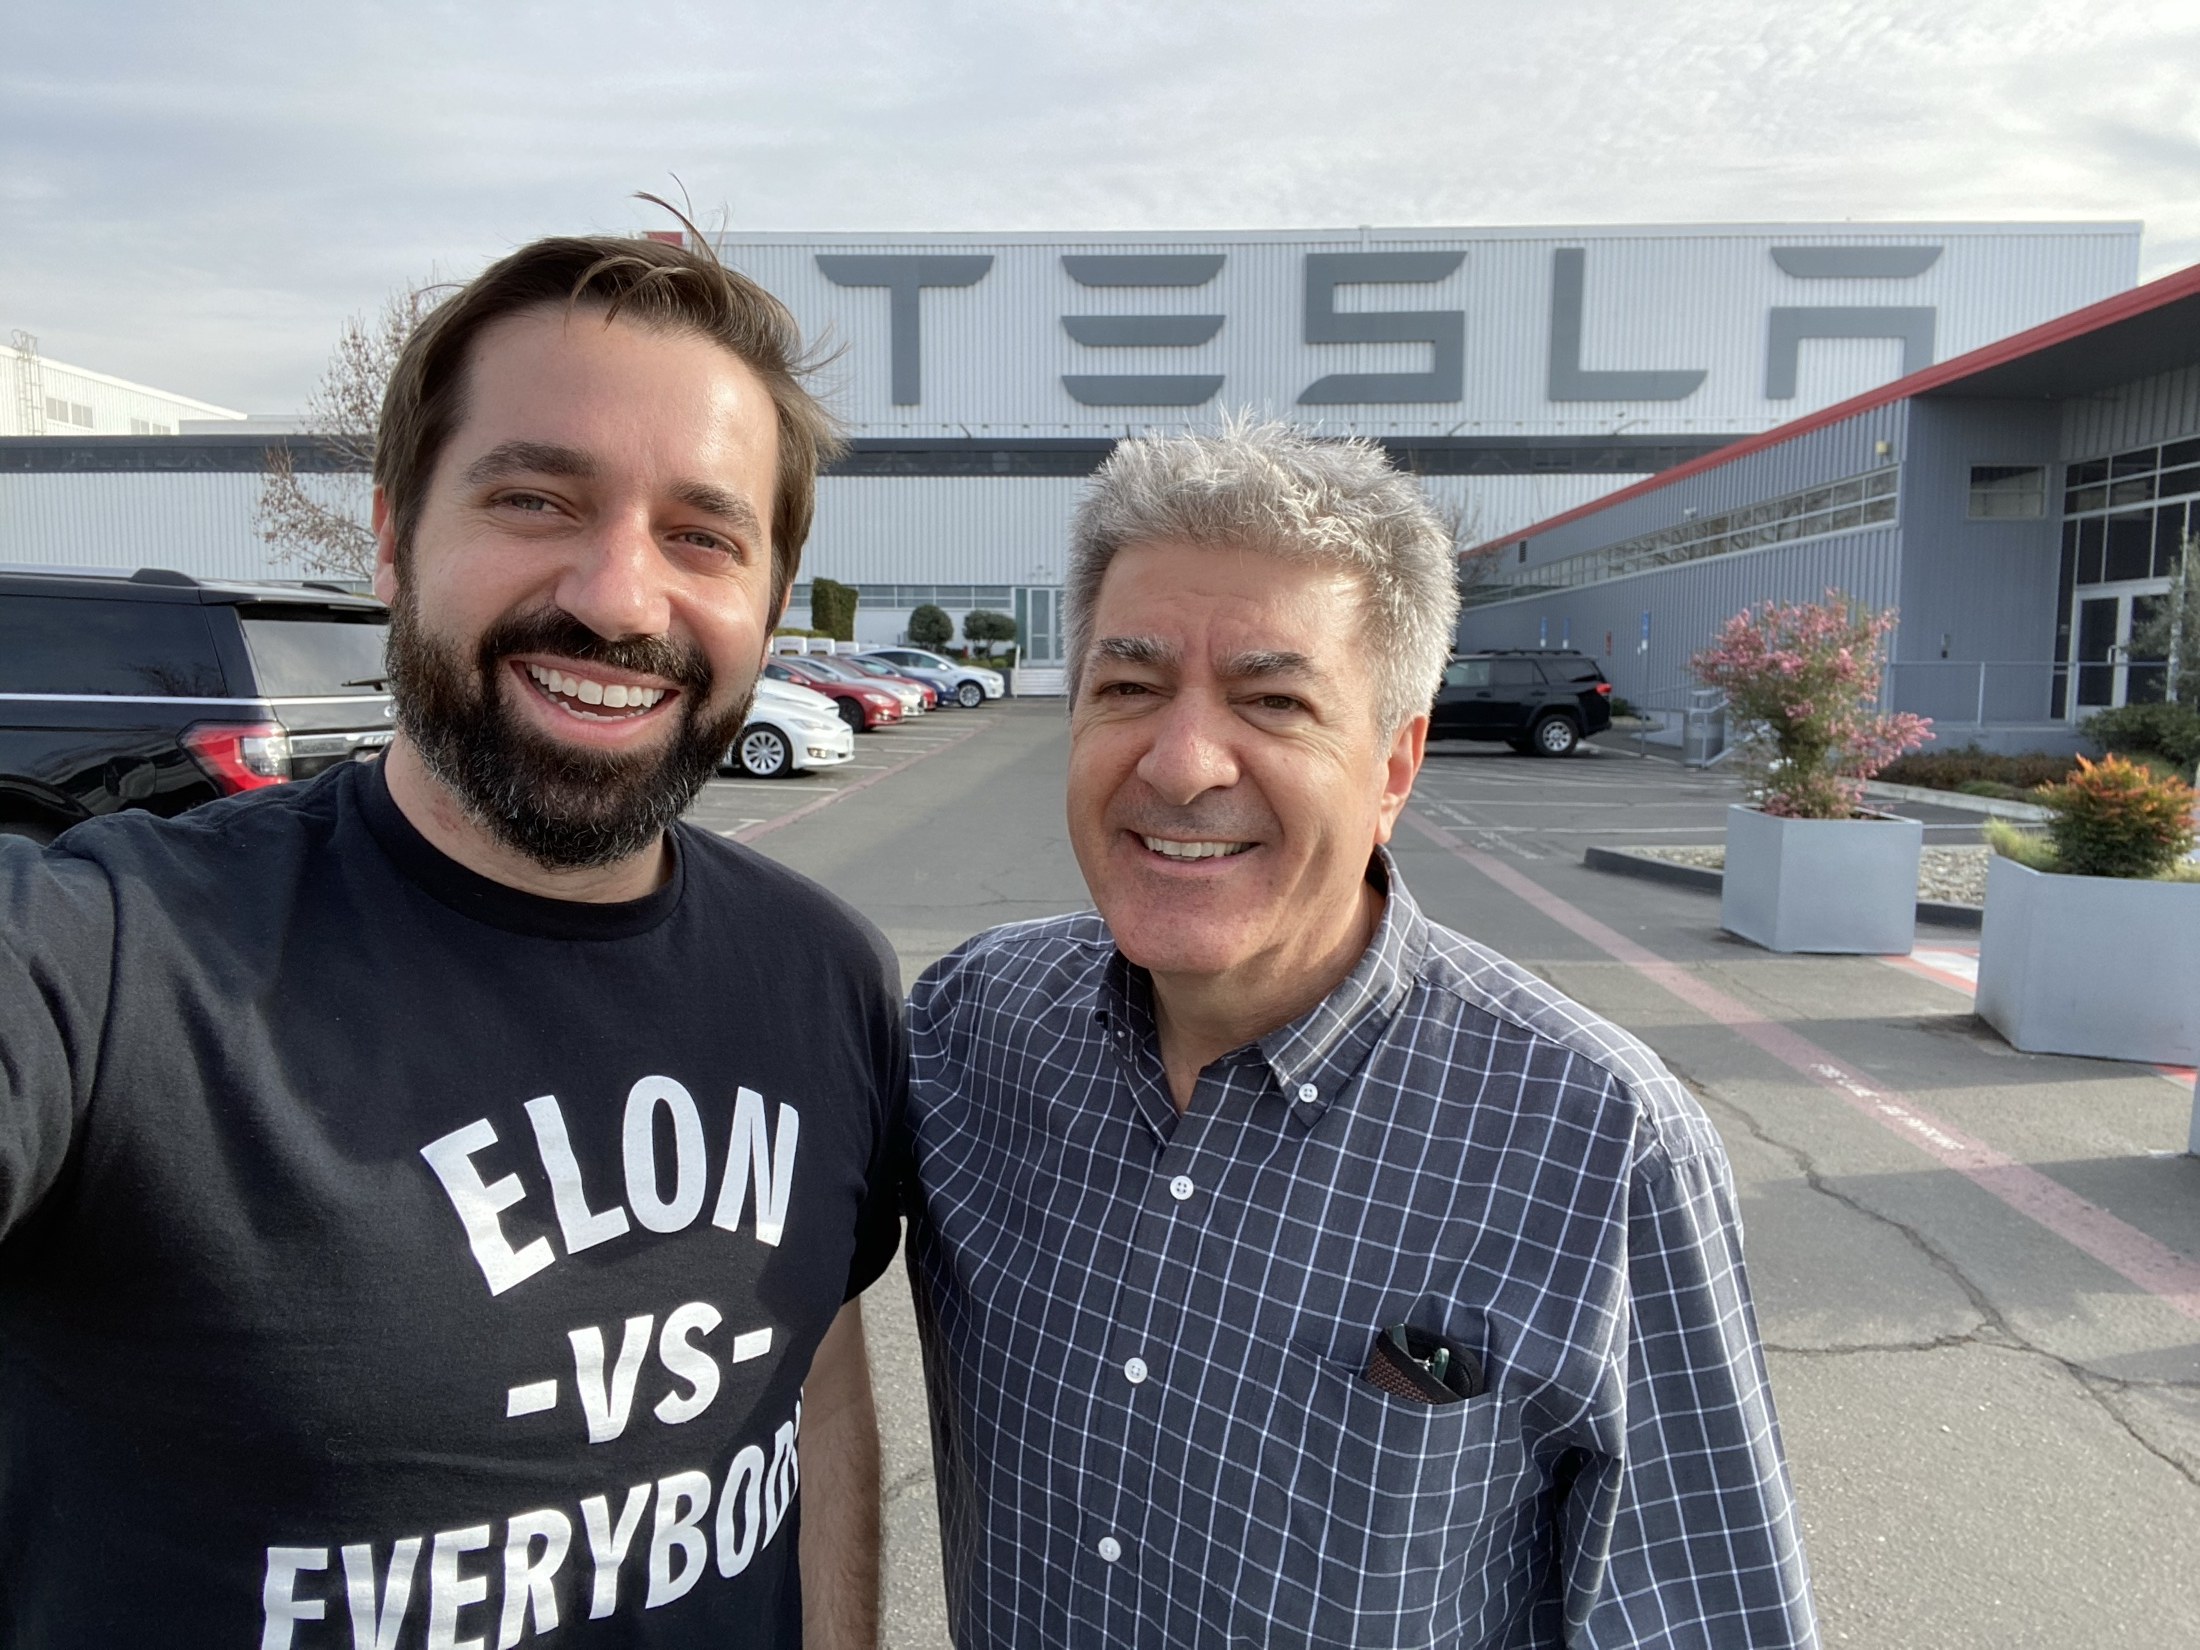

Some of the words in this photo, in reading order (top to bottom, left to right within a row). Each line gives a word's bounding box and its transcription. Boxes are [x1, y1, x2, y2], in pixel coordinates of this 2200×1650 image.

[815, 246, 1945, 406] TESLA
[420, 1075, 800, 1297] ELON
[260, 1388, 803, 1650] EVERYBOD
